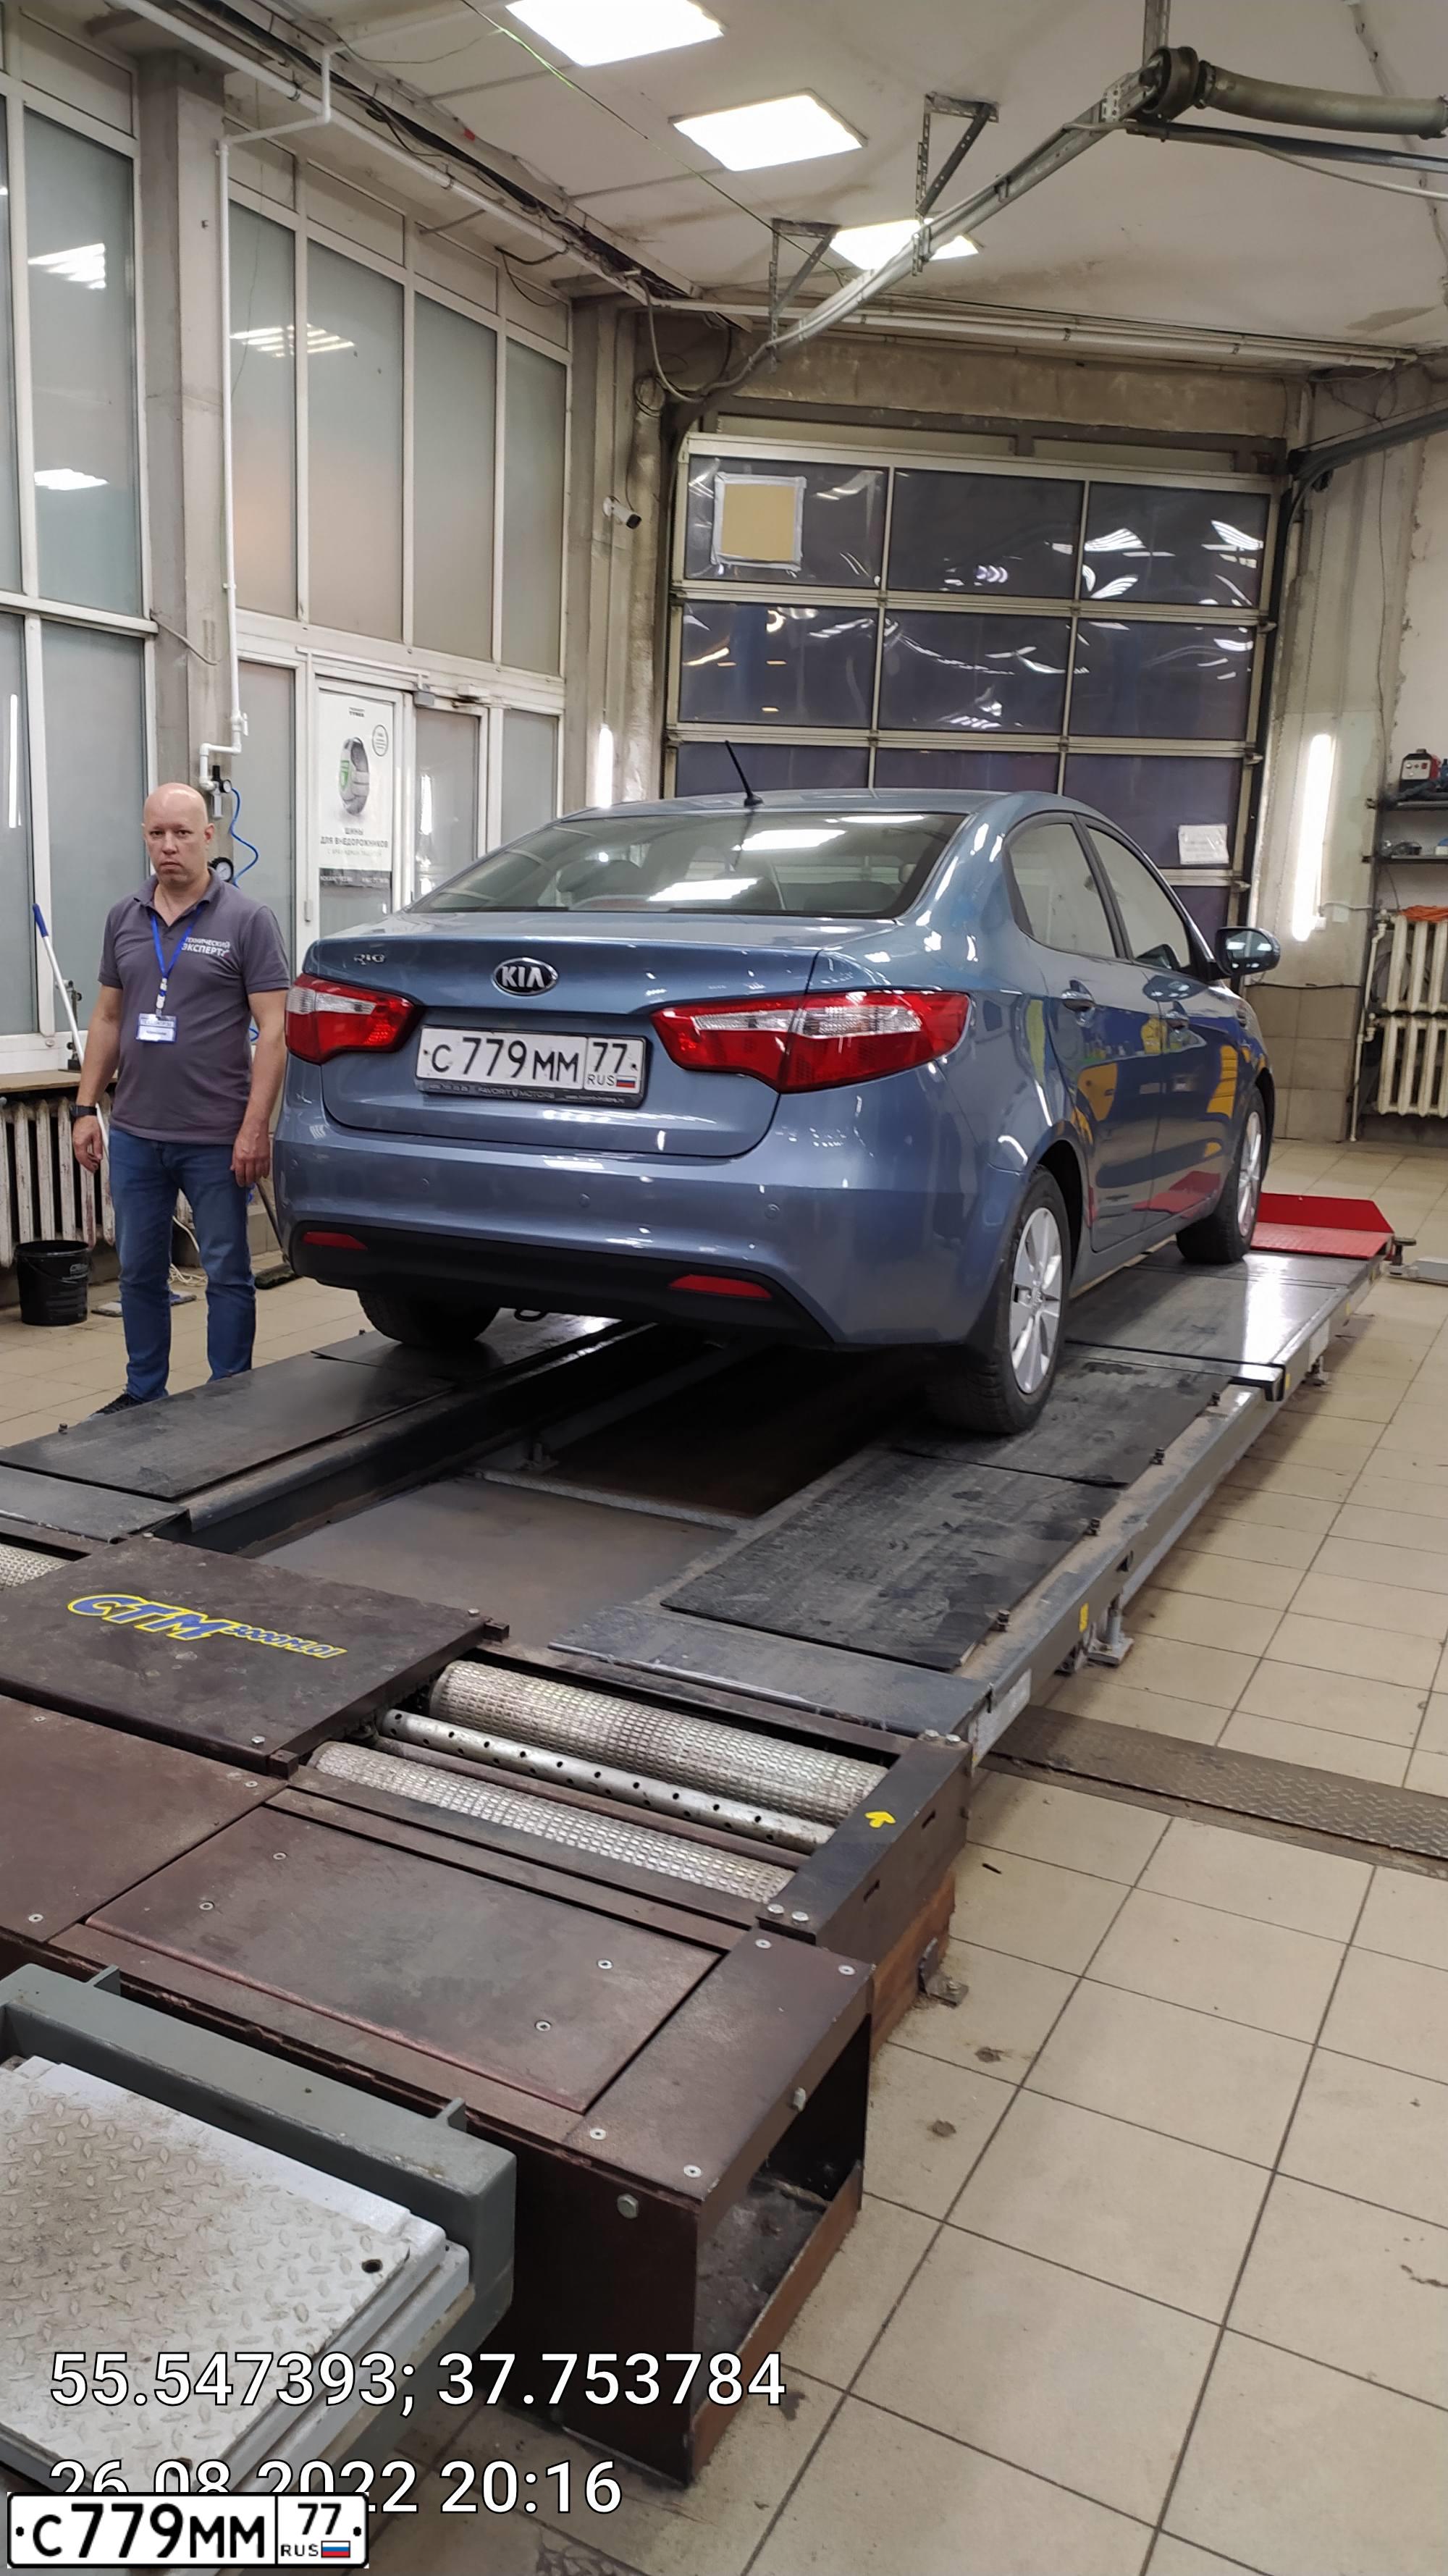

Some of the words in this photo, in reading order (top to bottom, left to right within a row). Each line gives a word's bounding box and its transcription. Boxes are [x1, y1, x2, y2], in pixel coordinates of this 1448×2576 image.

[182, 943, 222, 956] ЭКСПЕРТ
[501, 966, 544, 988] KIA
[593, 1041, 628, 1074] 77
[586, 1074, 615, 1087] RUS
